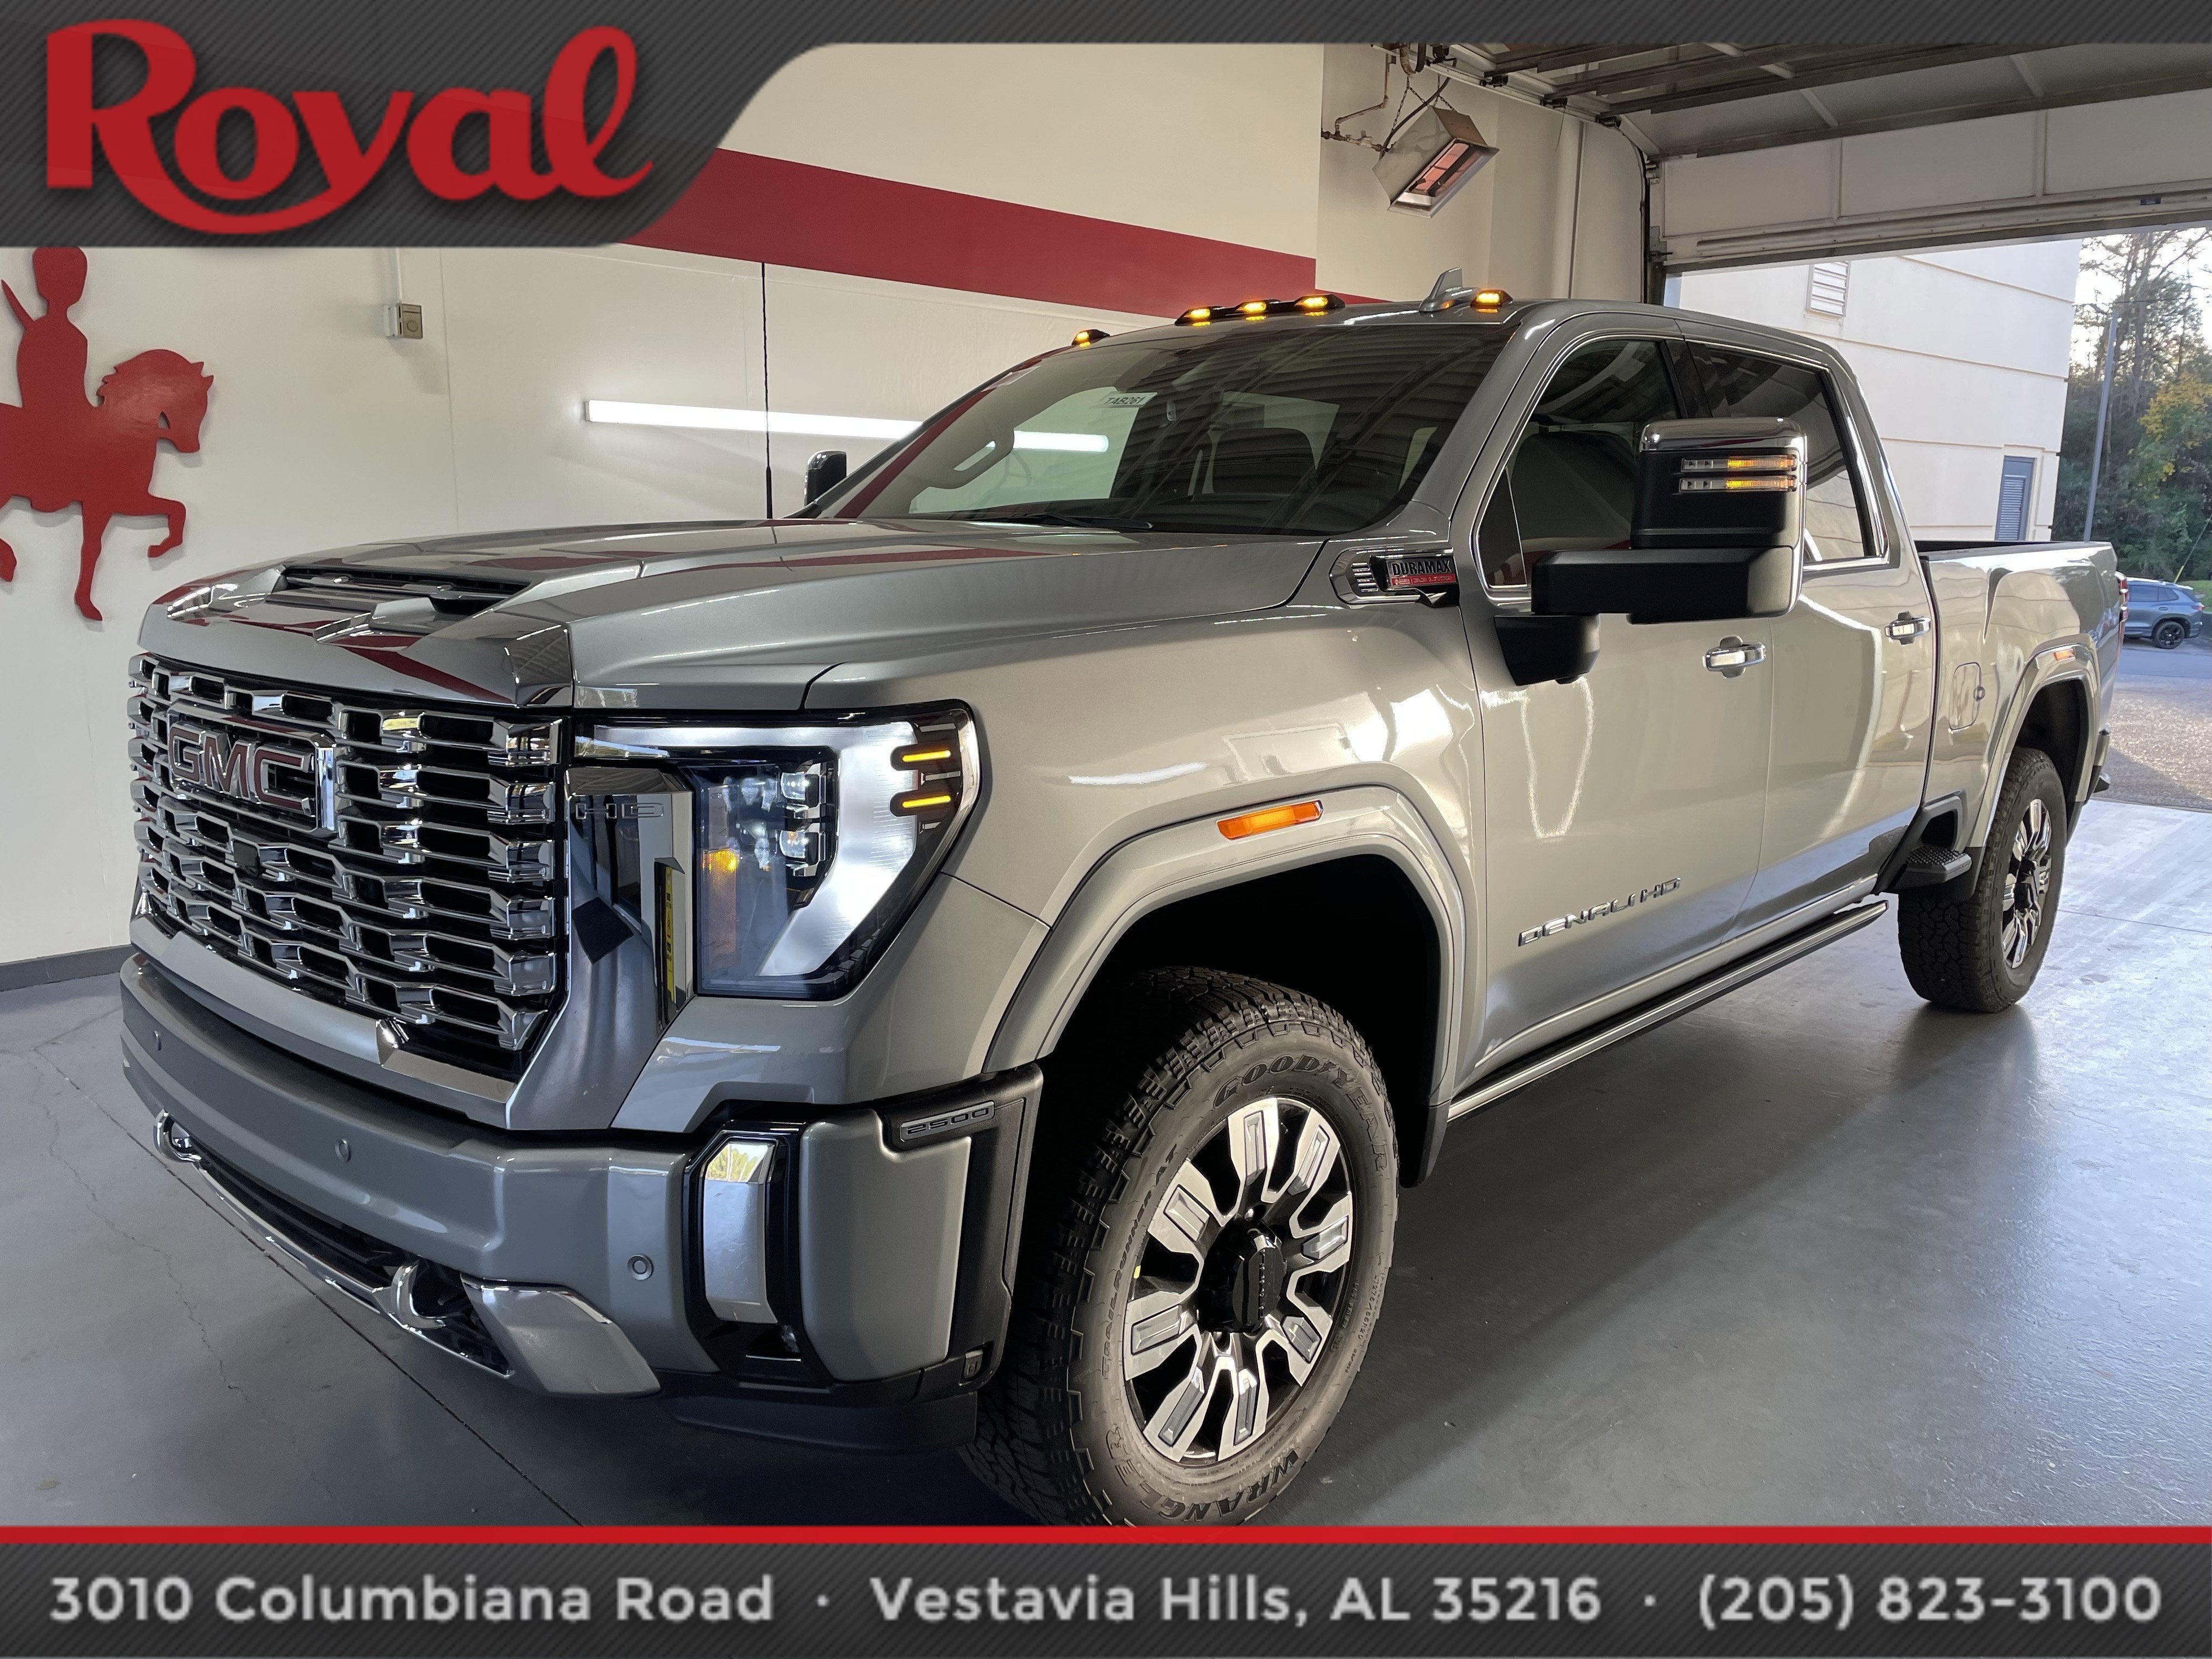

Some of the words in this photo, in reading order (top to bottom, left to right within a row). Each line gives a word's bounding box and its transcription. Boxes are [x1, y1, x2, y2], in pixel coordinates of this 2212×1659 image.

[1391, 560, 1452, 576] DURAMAX
[167, 723, 314, 817] GMC
[1517, 893, 1635, 947] DENALI
[1640, 877, 1681, 903] HD
[907, 1108, 989, 1135] 2500
[1213, 1053, 1389, 1172] GOODYEAR
